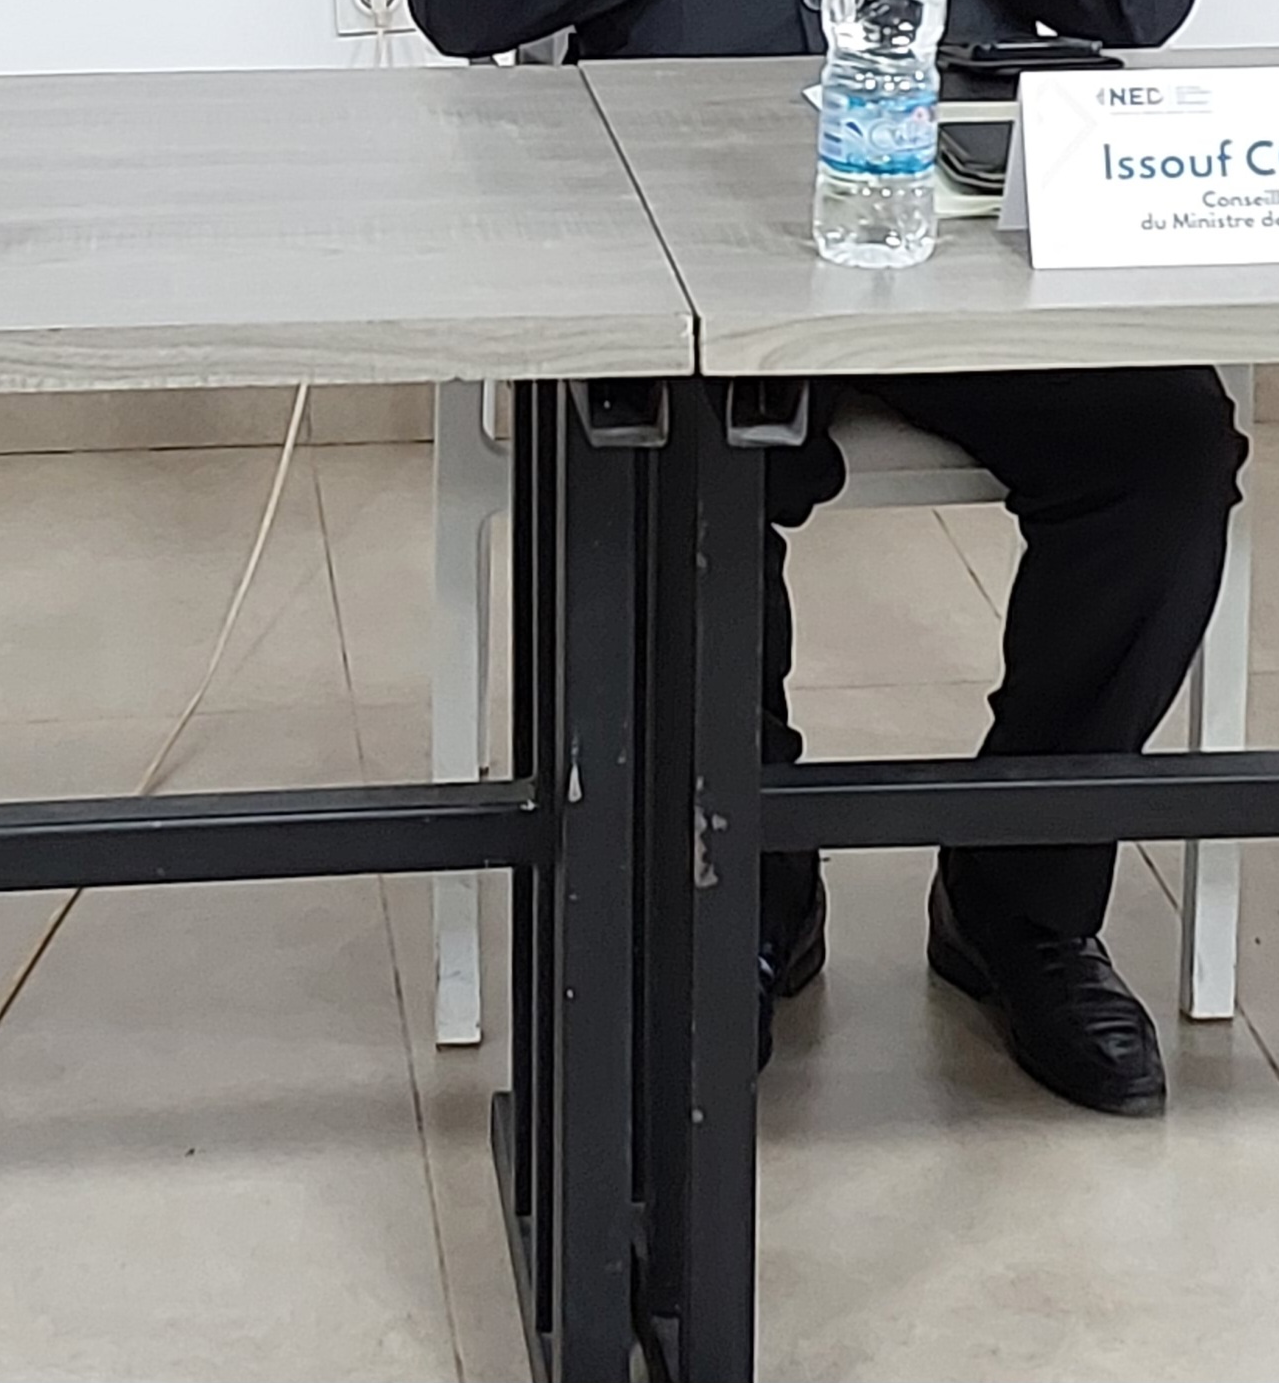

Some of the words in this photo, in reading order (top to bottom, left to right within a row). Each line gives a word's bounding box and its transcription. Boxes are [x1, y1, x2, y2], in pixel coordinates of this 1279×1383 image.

[1109, 87, 1164, 107] NED
[1102, 138, 1233, 180] Issouf
[1141, 212, 1167, 231] du
[1172, 212, 1256, 231] Ministre
